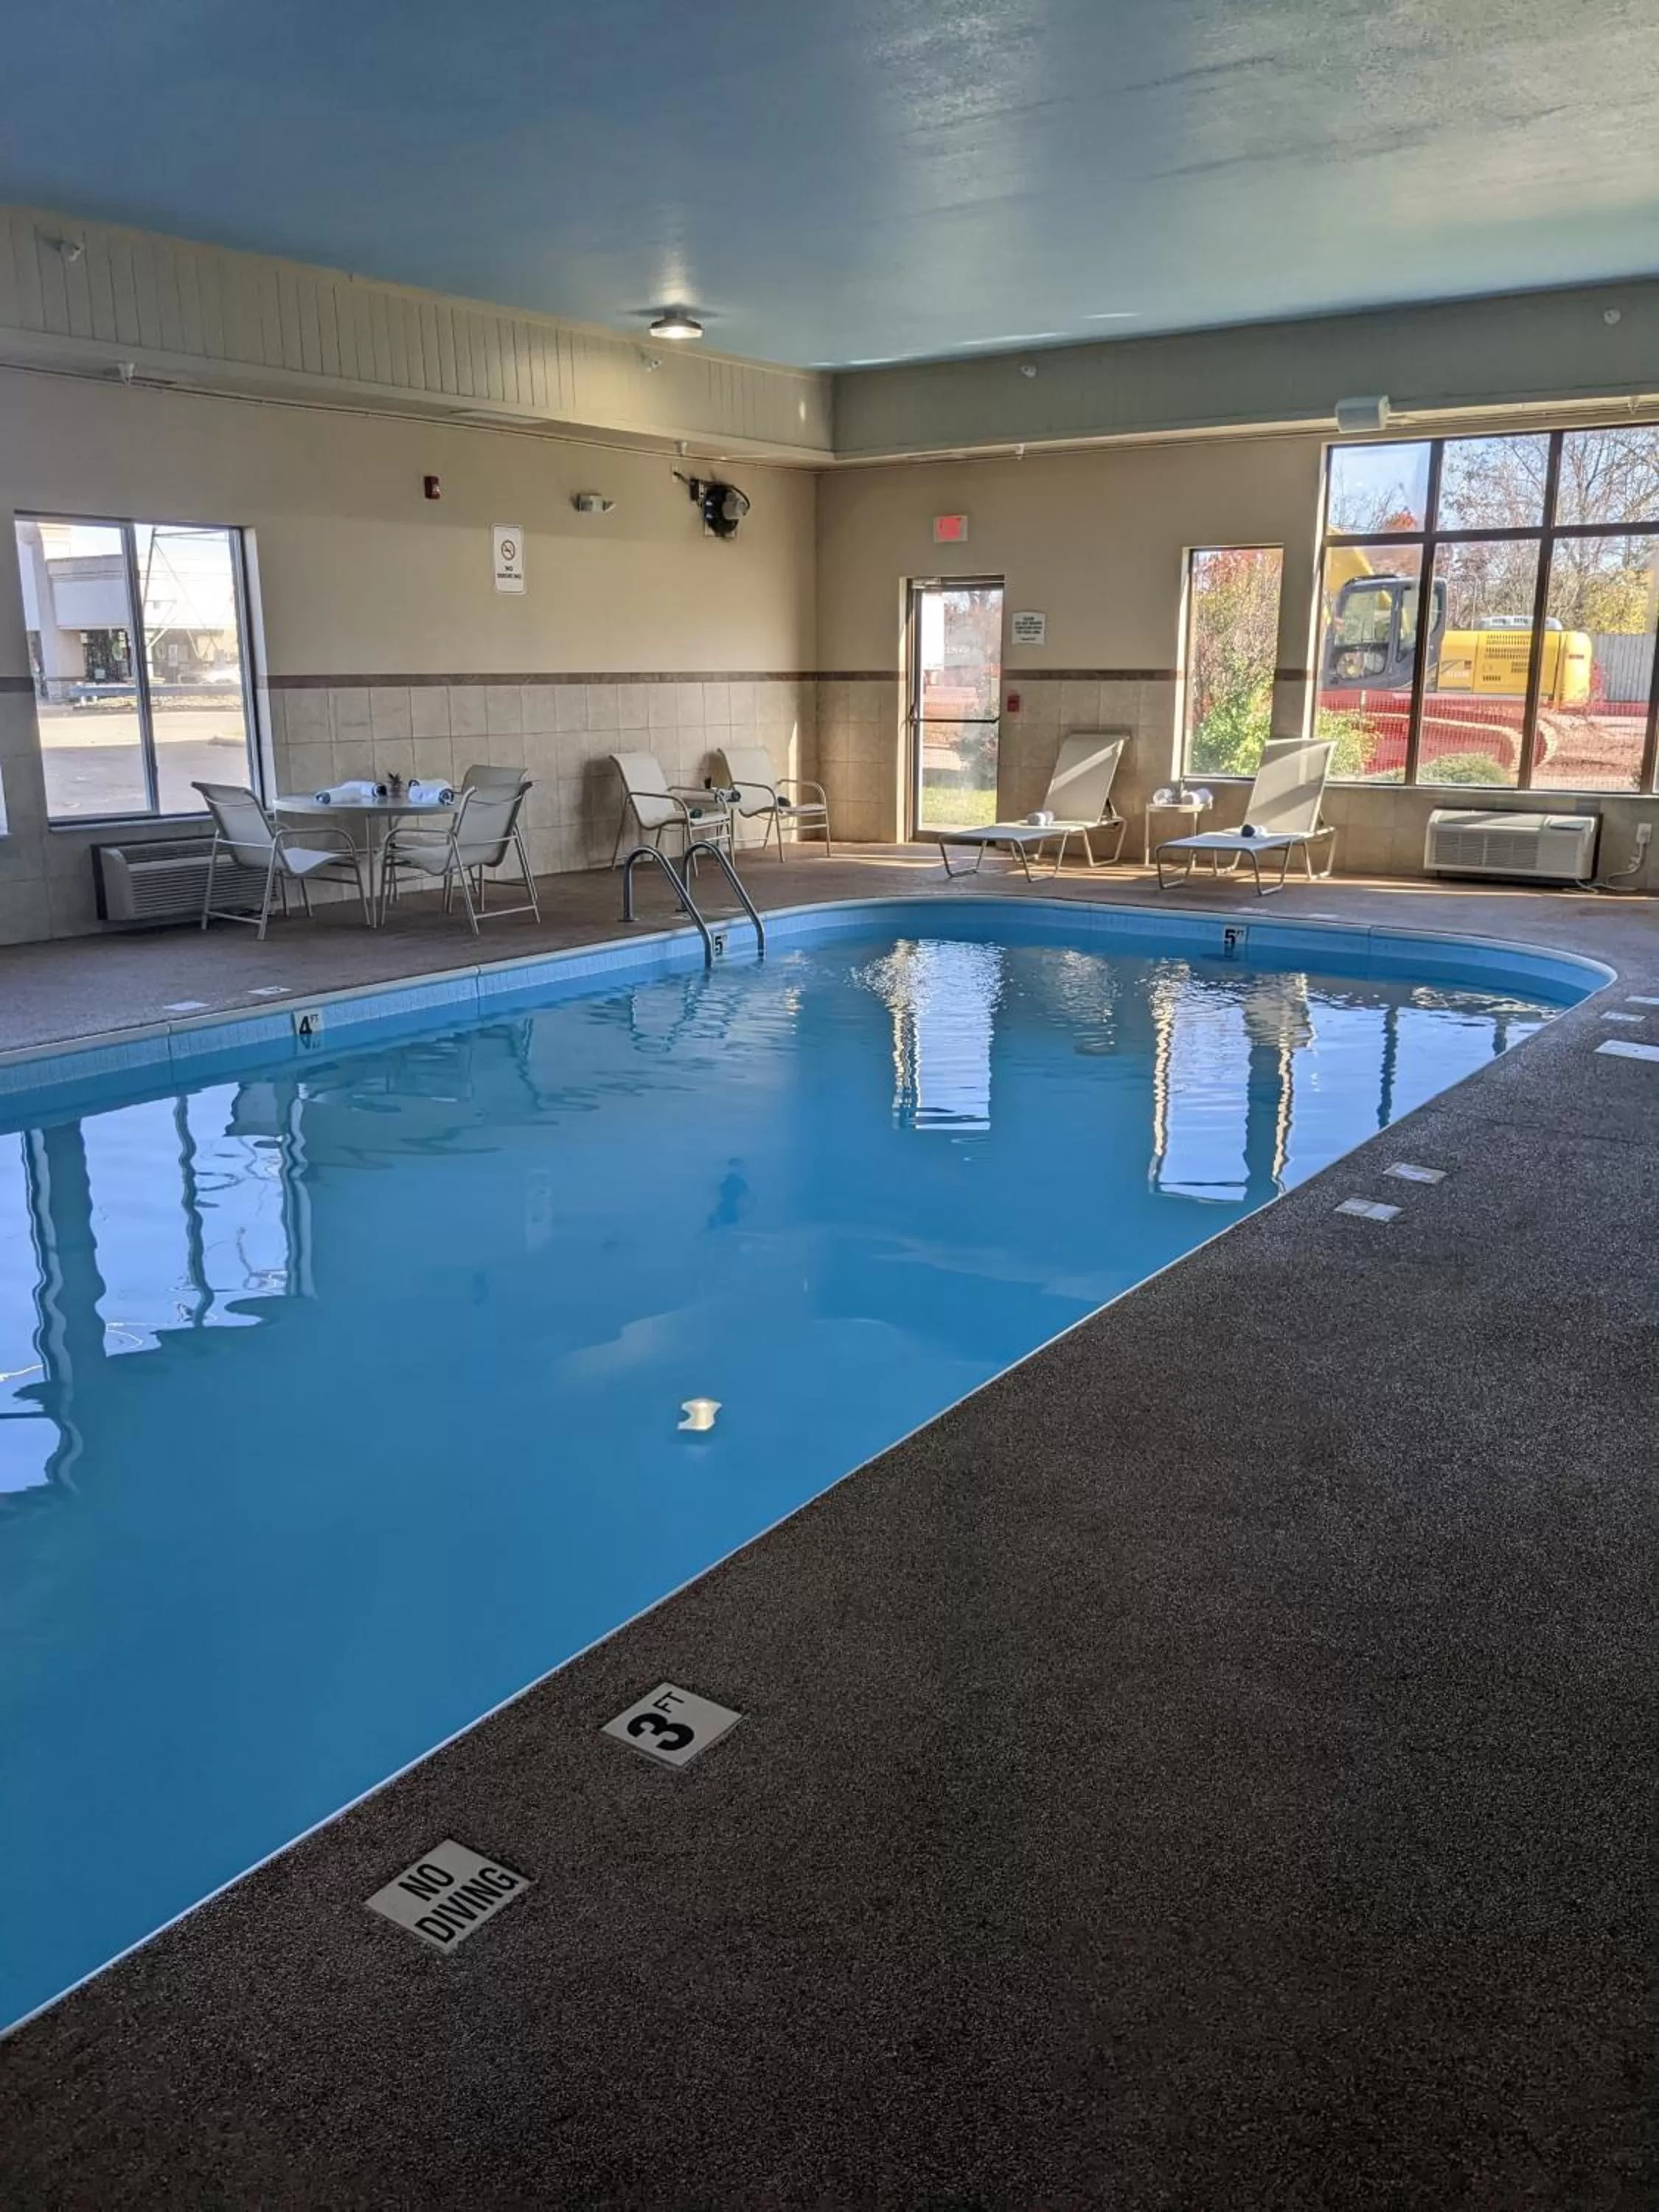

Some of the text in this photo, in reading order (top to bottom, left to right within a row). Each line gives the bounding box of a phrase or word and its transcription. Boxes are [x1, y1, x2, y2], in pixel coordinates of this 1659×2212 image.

[715, 936, 723, 956] 5
[1225, 929, 1236, 946] 5
[299, 1014, 319, 1034] 4 FT
[627, 1691, 695, 1752] 3 FT
[397, 1863, 455, 1902] NO
[414, 1865, 520, 1944] DIVING
